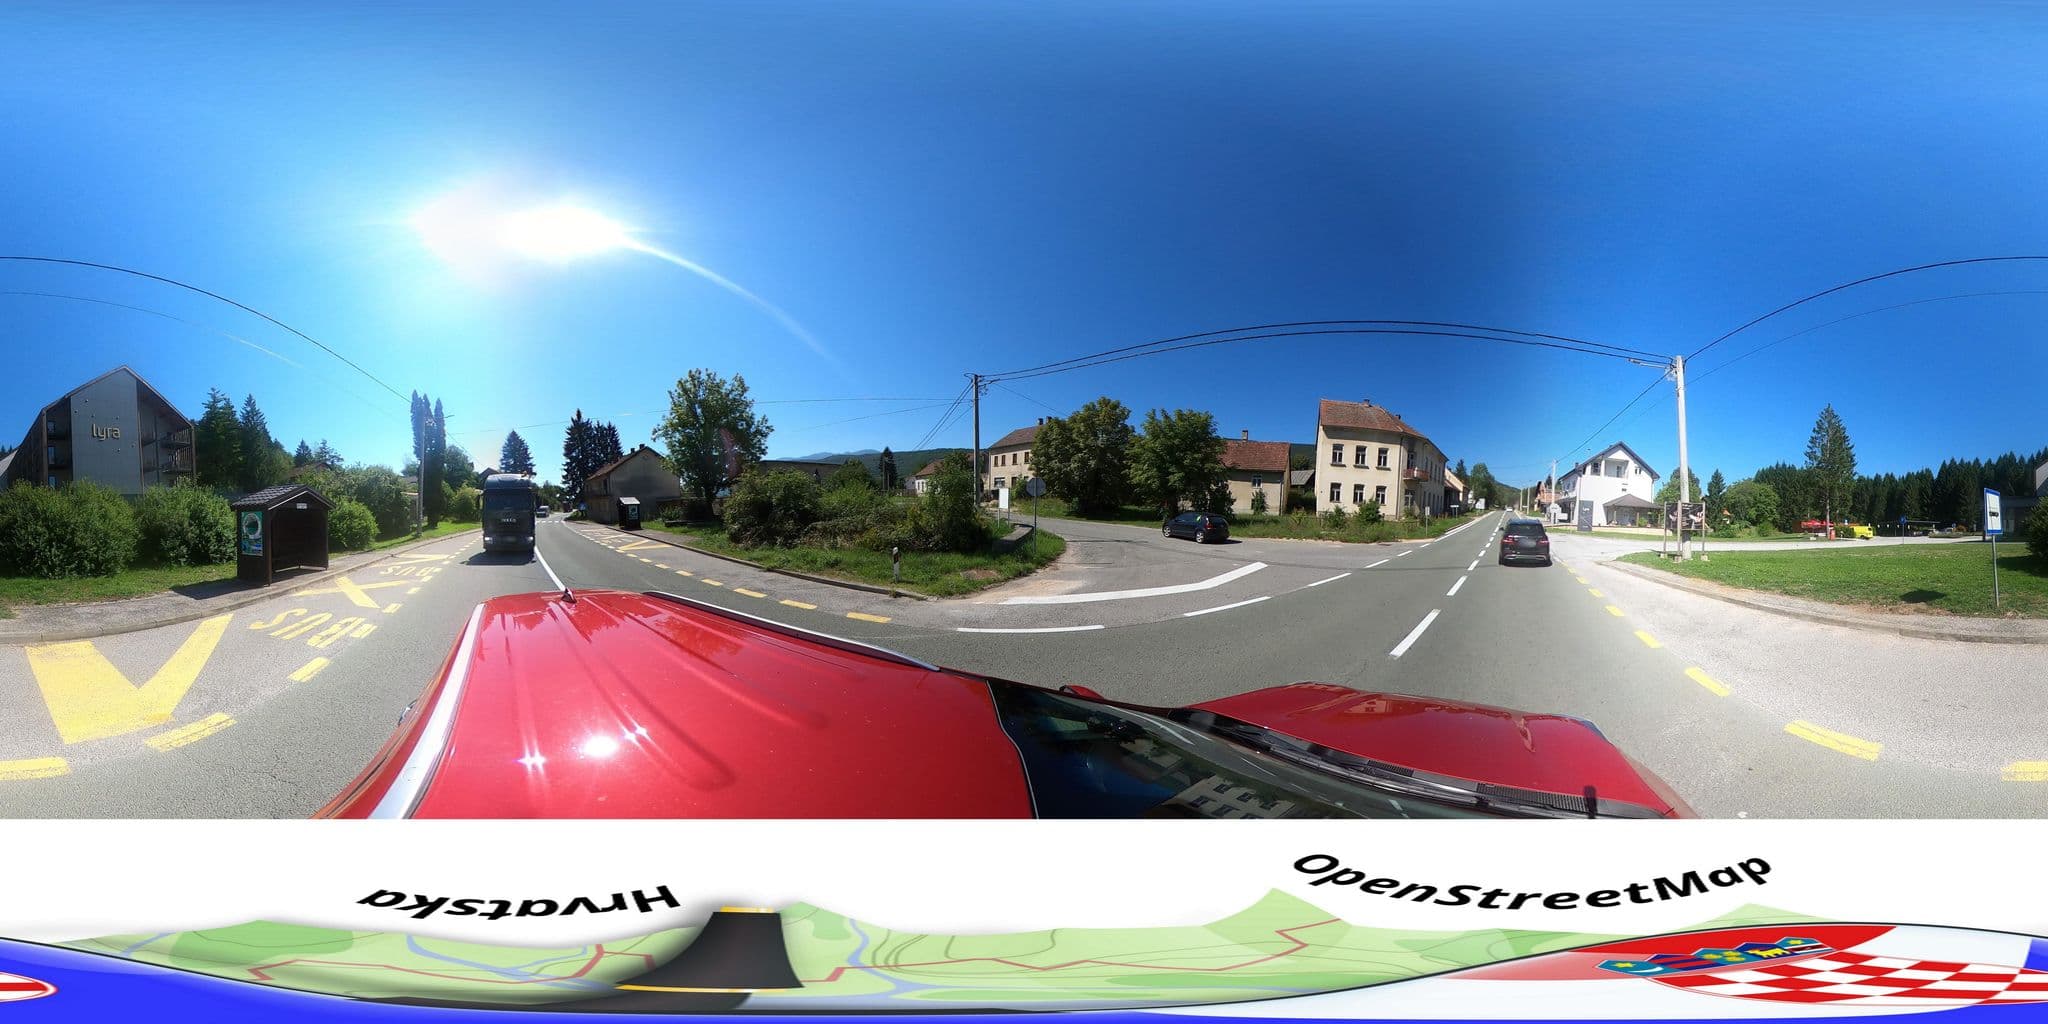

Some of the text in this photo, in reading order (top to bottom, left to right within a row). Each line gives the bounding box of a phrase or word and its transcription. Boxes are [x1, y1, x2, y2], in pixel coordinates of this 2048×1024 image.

[92, 423, 121, 441] lyra
[379, 565, 433, 577] BUS
[248, 608, 367, 649] BUS
